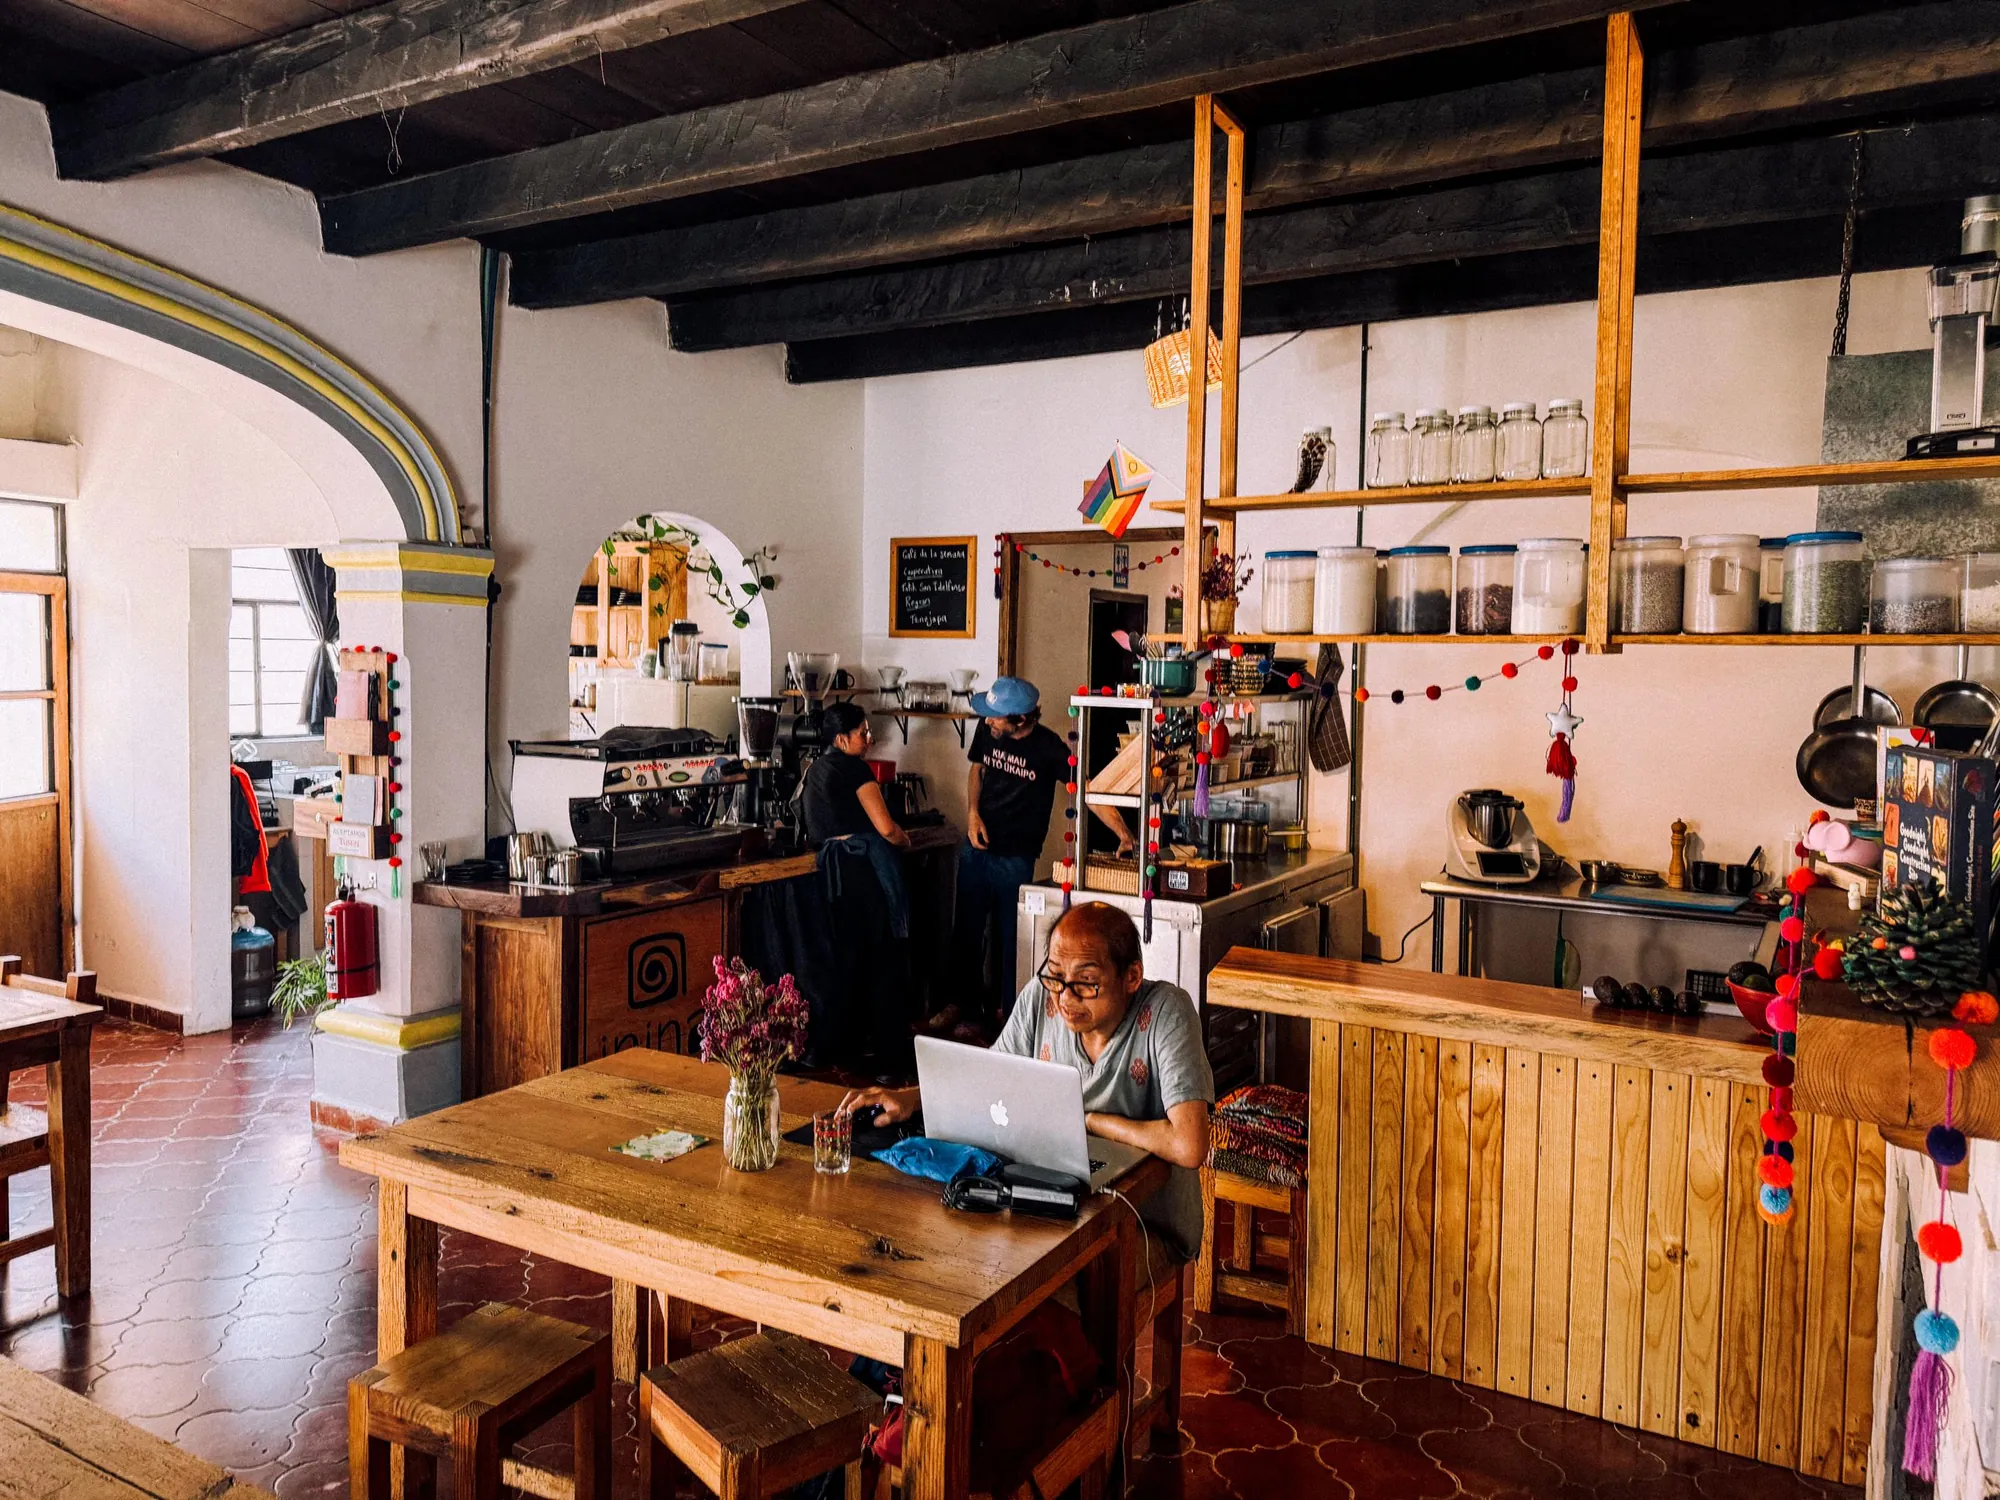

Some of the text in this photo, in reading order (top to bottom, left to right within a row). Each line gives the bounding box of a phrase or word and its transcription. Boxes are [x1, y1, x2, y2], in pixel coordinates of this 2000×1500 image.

[930, 548, 938, 559] la
[940, 550, 965, 559] semana
[983, 754, 991, 766] KI
[993, 748, 1026, 768] KIA MAU
